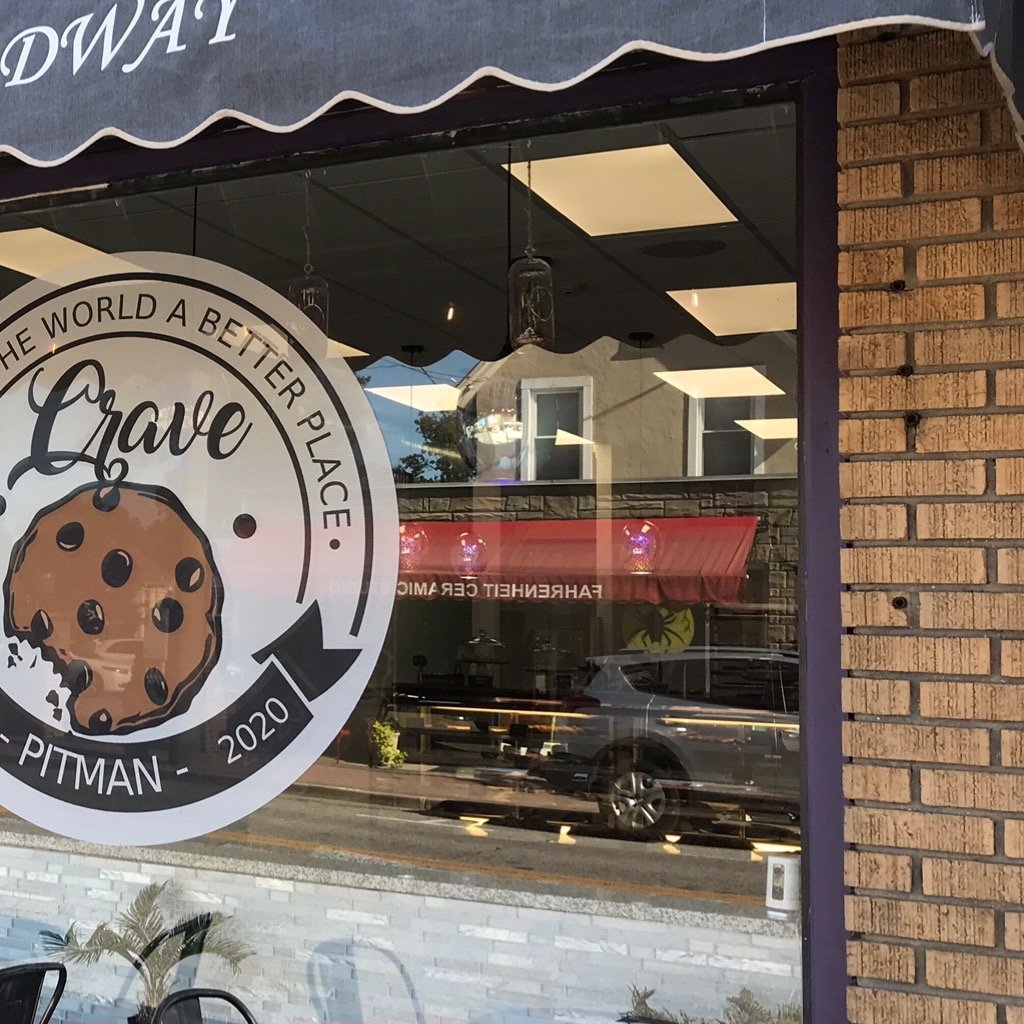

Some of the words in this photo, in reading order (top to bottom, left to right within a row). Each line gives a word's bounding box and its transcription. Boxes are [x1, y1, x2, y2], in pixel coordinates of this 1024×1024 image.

[7, 358, 253, 490] Crave
[41, 293, 157, 339] WORLD
[166, 298, 187, 327] A
[198, 307, 306, 410] BETTER
[296, 409, 351, 530] PLACE
[18, 733, 163, 797] PITMAN
[217, 696, 289, 765] 2020
